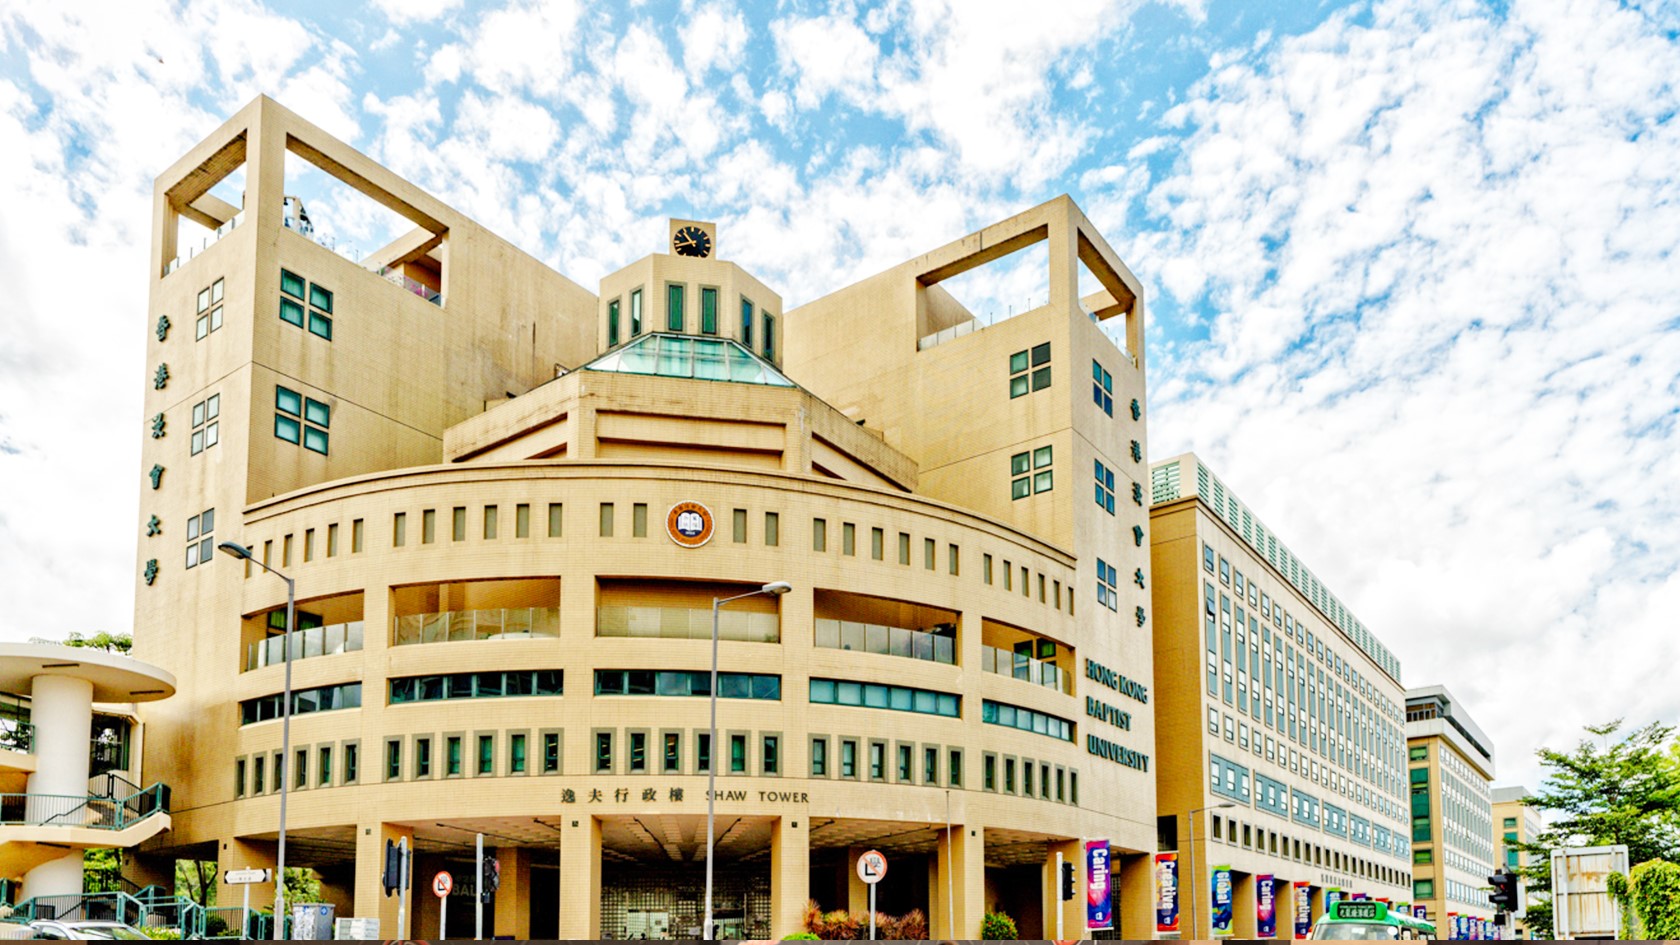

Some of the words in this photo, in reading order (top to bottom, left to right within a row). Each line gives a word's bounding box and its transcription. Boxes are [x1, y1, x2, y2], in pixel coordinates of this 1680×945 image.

[1085, 658, 1117, 691] HONG
[1119, 674, 1148, 705] KONG
[1086, 695, 1131, 731] BAPTIST
[1087, 733, 1149, 773] UNIVERSITY
[560, 787, 684, 804] 逸夫行政樓
[705, 790, 747, 802] SHAW
[758, 791, 809, 804] TOWER
[1090, 848, 1109, 890] Caring
[1162, 861, 1177, 909] Creative
[1216, 872, 1230, 904] Global
[1259, 880, 1273, 910] Caring
[1299, 887, 1311, 923] Creative
